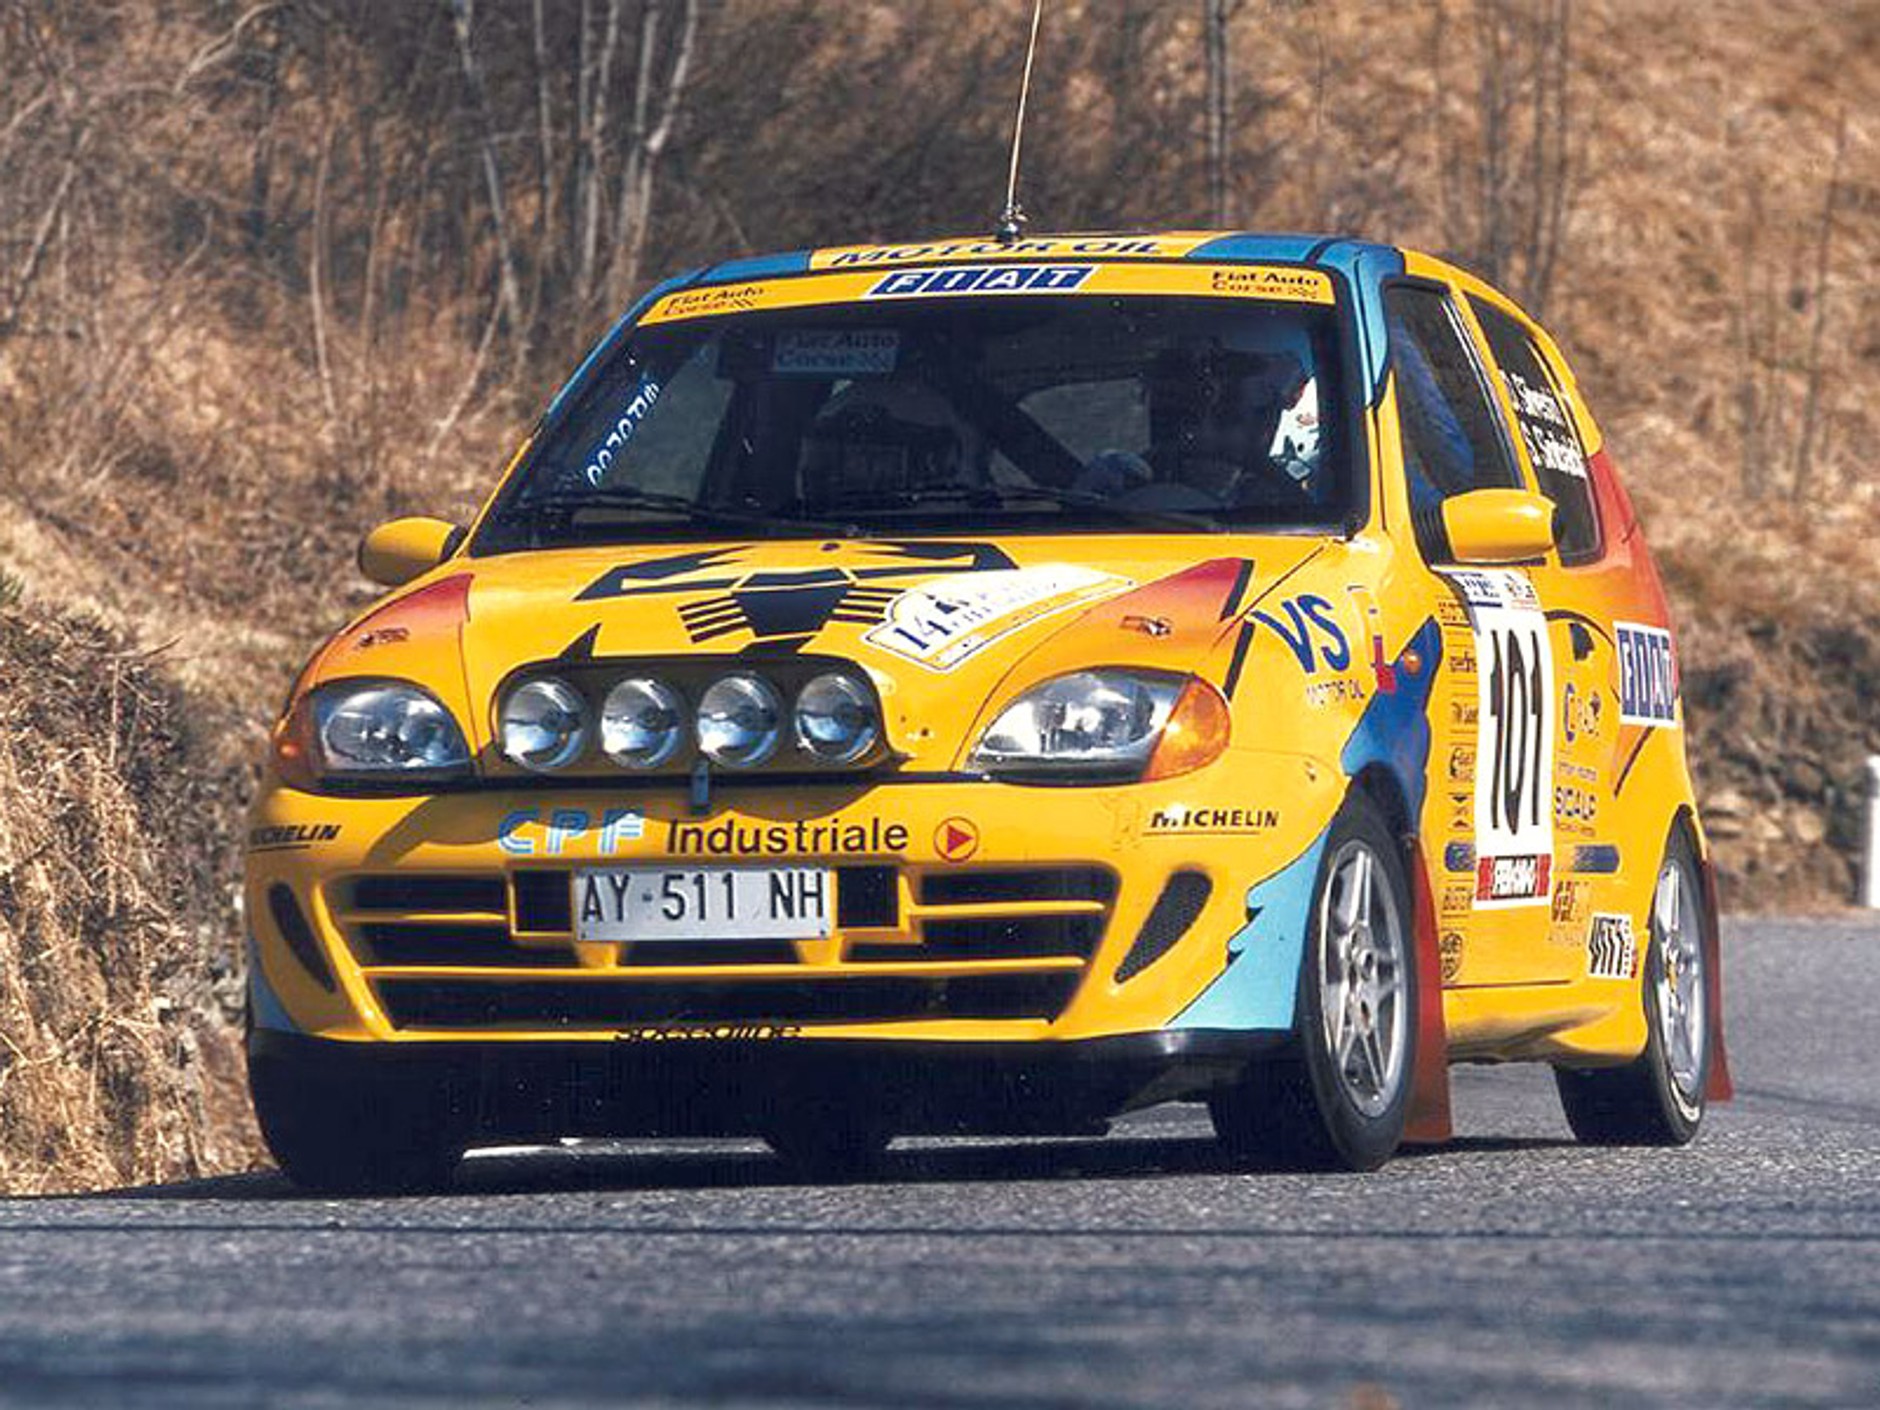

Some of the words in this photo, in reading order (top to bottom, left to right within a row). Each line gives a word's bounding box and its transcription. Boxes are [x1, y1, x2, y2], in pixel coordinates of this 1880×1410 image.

[1073, 241, 1163, 254] OIL
[668, 293, 711, 307] Fiat
[713, 286, 765, 300] Auto
[868, 264, 1094, 296] FIAT
[1212, 270, 1257, 281] Fiat
[1263, 272, 1319, 287] Auto
[1250, 594, 1350, 672] VS
[1616, 627, 1675, 721] FIAT
[1488, 627, 1543, 836] 101
[499, 808, 646, 855] CPF
[666, 816, 909, 855] Industriale
[1150, 809, 1280, 828] MICHELIN
[769, 870, 824, 919] NH
